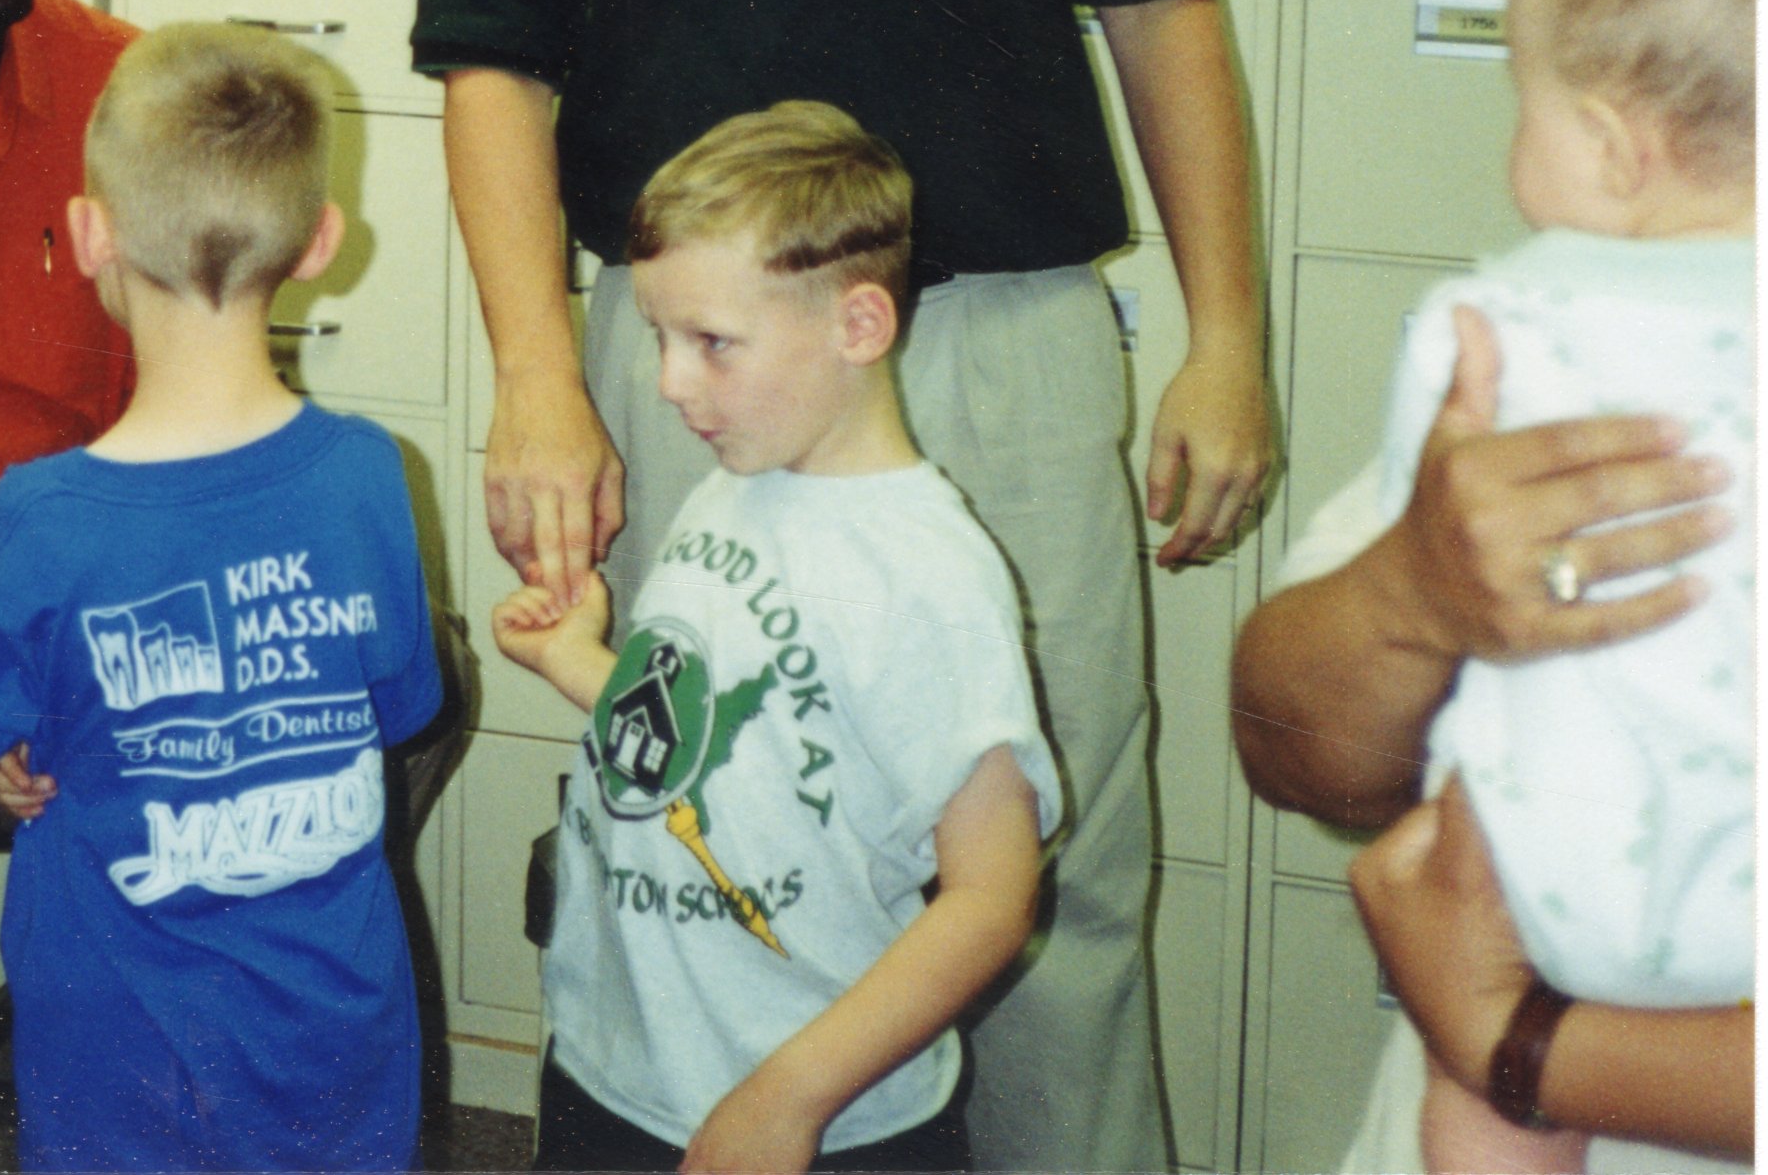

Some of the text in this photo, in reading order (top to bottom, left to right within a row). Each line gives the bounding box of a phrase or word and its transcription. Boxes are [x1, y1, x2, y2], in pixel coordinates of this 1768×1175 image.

[225, 550, 312, 606] KIRK
[235, 643, 319, 693] D.D.S.
[663, 530, 835, 828] GOOD LOOK AT
[117, 703, 373, 766] Family Dentist
